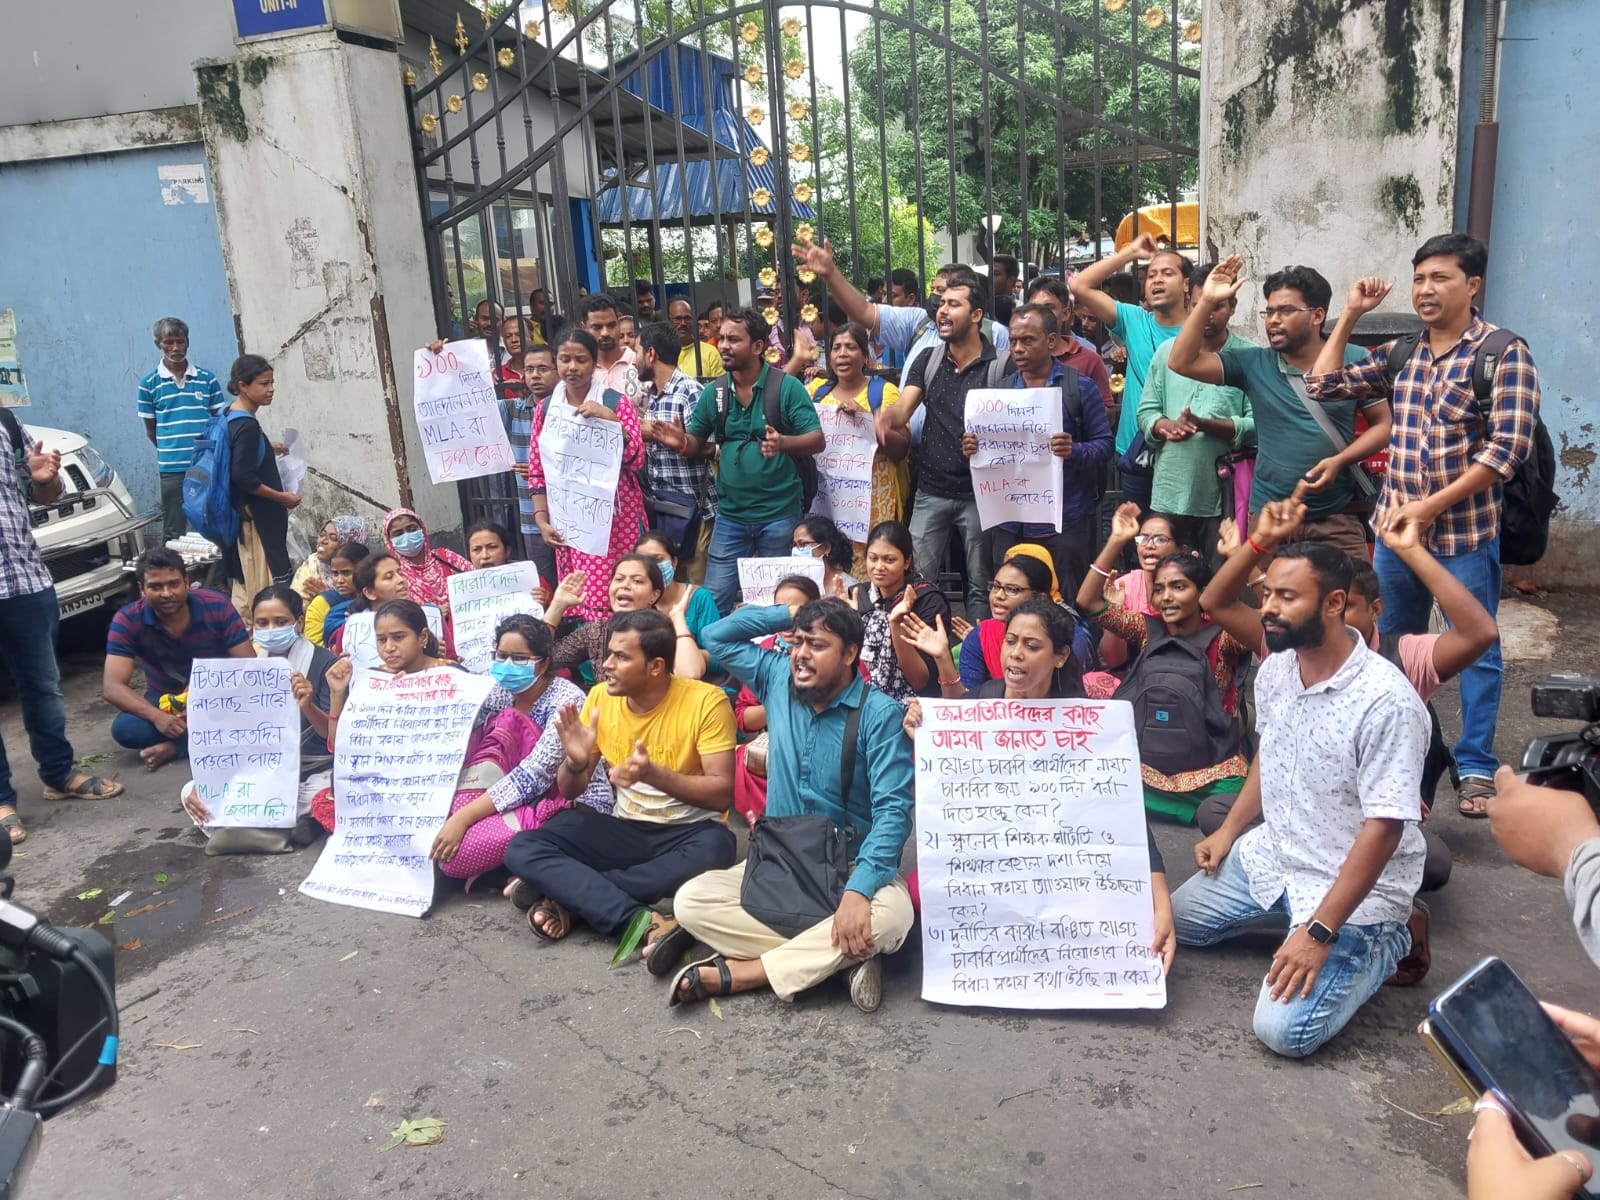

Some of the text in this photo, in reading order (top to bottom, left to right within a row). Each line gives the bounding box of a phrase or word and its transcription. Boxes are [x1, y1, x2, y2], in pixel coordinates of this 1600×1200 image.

[933, 701, 1105, 730] জনপ্রতিনিধিদের কাছে
[192, 729, 225, 745] আর
[992, 730, 1047, 751] জানতে
[1101, 831, 1115, 845] ও
